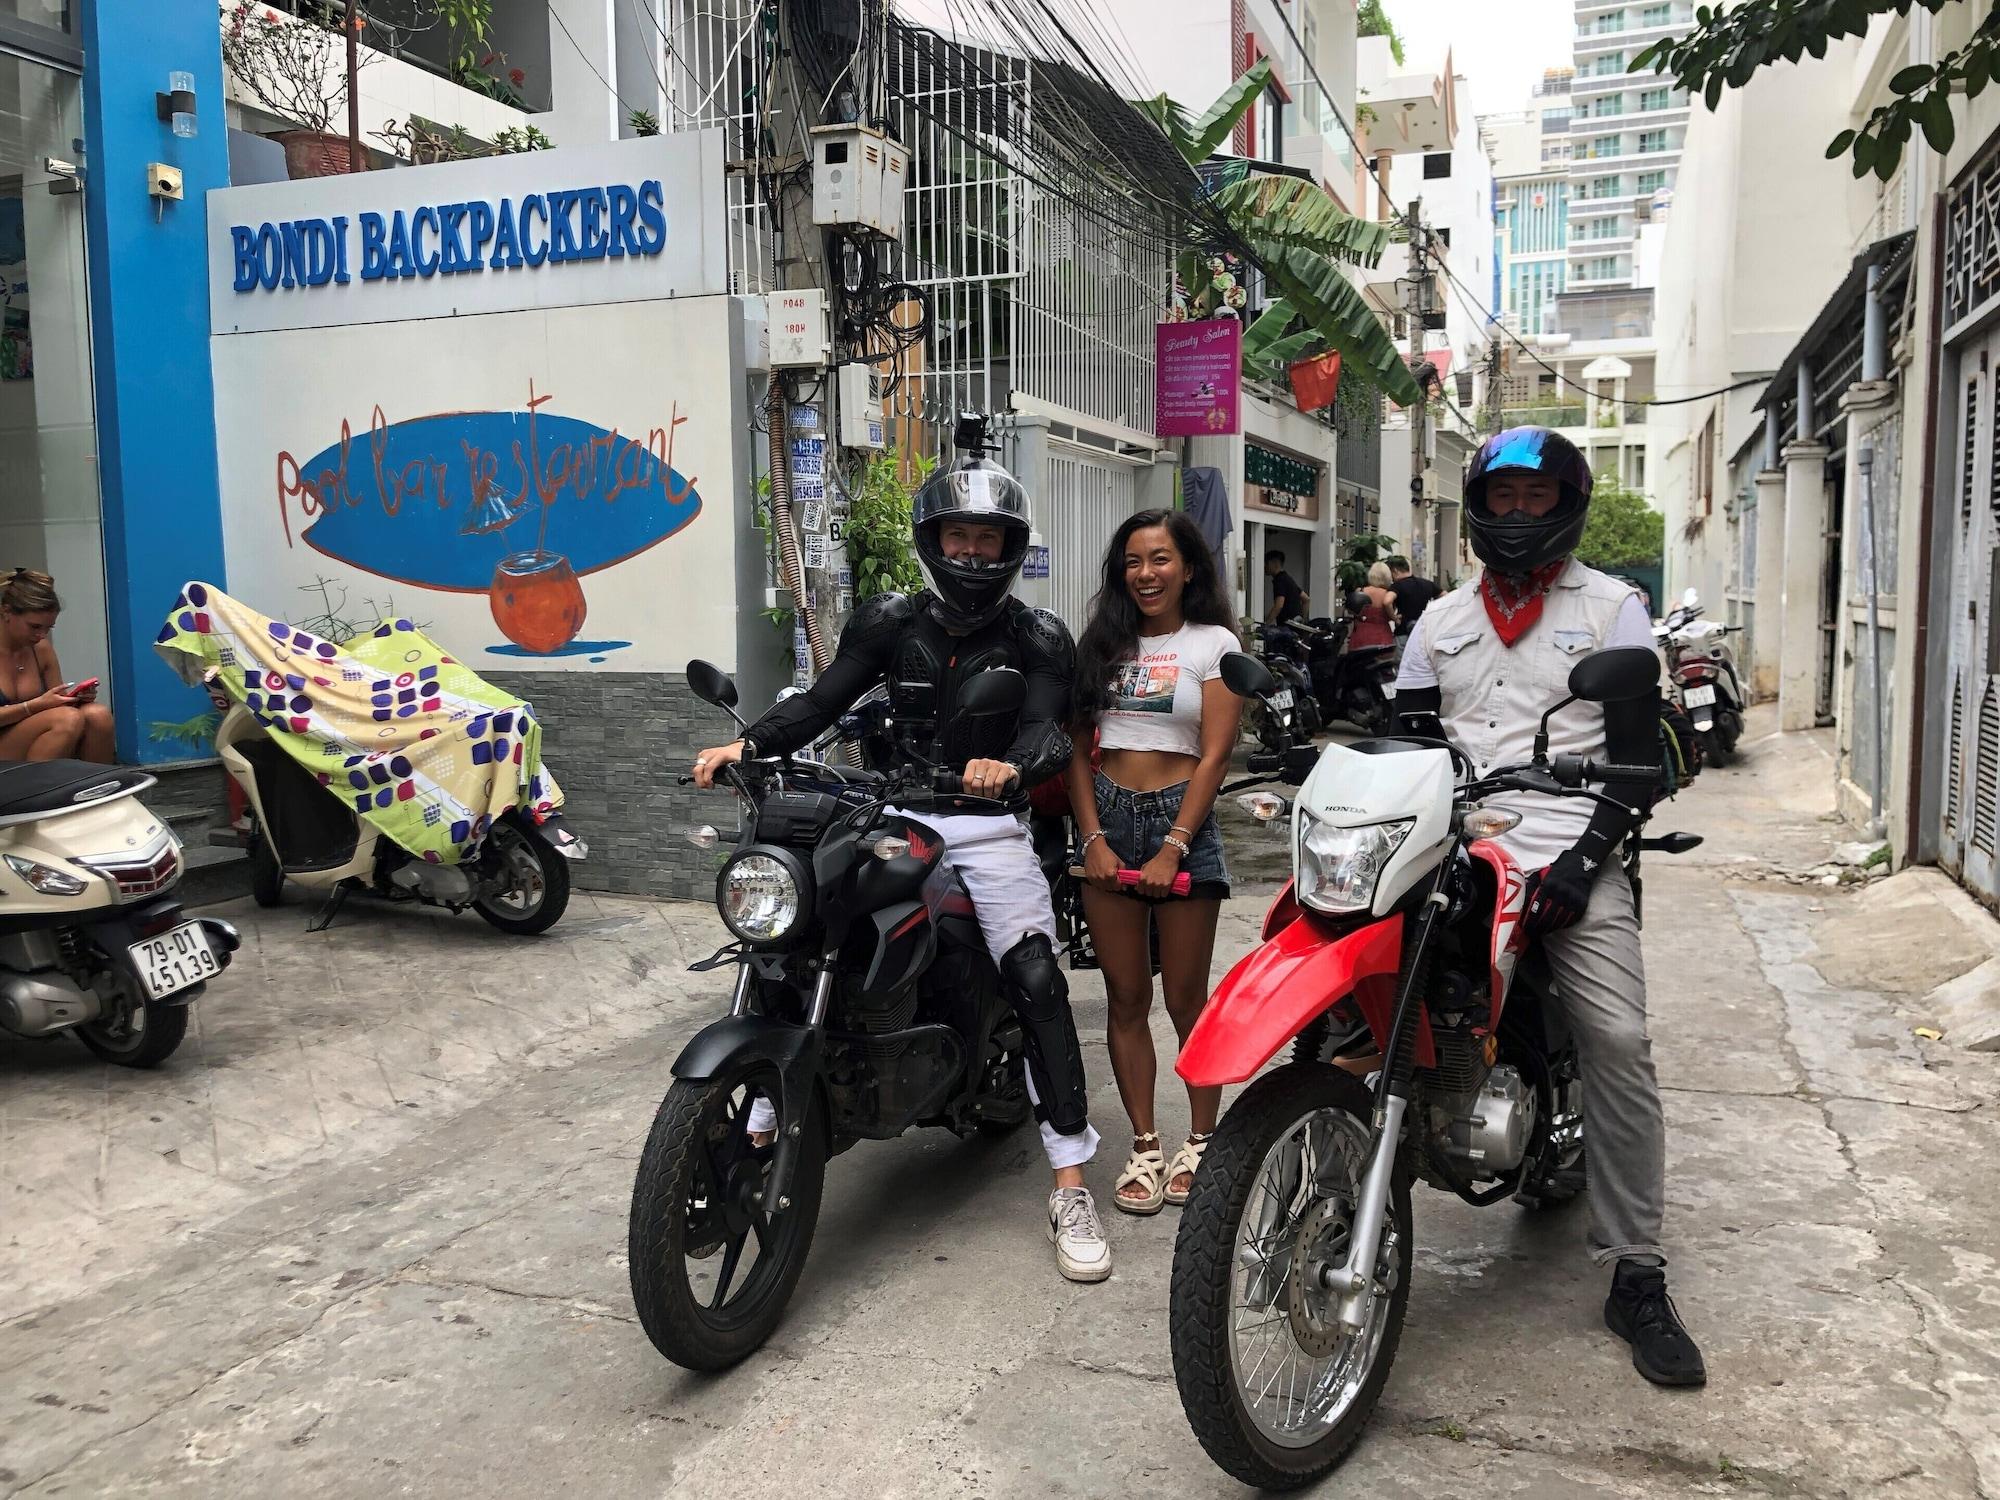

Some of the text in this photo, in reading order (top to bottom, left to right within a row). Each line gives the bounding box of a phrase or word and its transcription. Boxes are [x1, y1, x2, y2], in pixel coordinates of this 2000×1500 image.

[231, 179, 668, 292] BONDI BACKPACKERS
[1164, 326, 1230, 352] Beauty Salon
[372, 404, 451, 517] bar
[461, 378, 699, 506] restaurant
[1325, 806, 1368, 815] HONDA
[149, 949, 215, 993] 451.39
